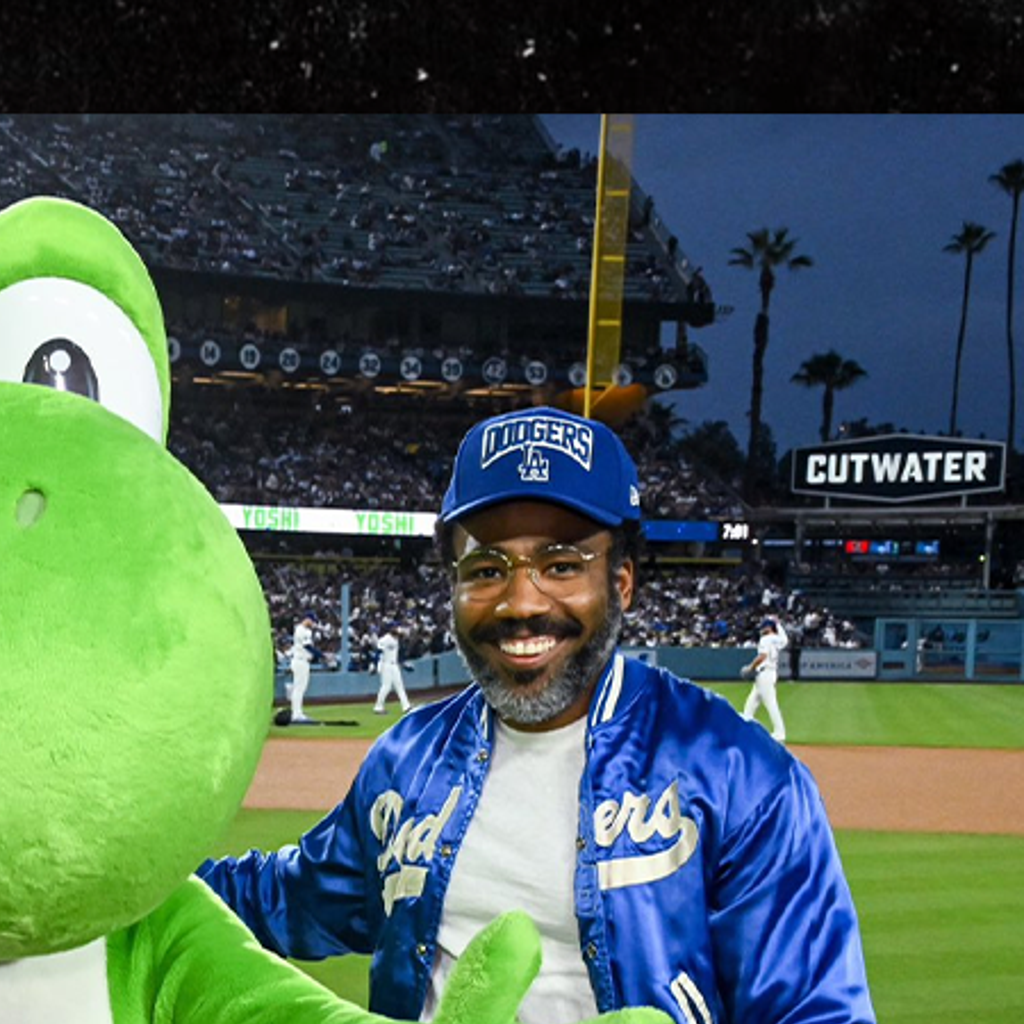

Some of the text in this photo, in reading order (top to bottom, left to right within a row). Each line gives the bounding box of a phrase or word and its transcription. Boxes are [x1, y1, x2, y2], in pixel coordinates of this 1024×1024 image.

[482, 416, 593, 471] DODGERS
[518, 443, 549, 482] LA
[806, 451, 987, 485] CUTWATER
[242, 506, 300, 530] YOSHI
[355, 511, 415, 535] YOSHI
